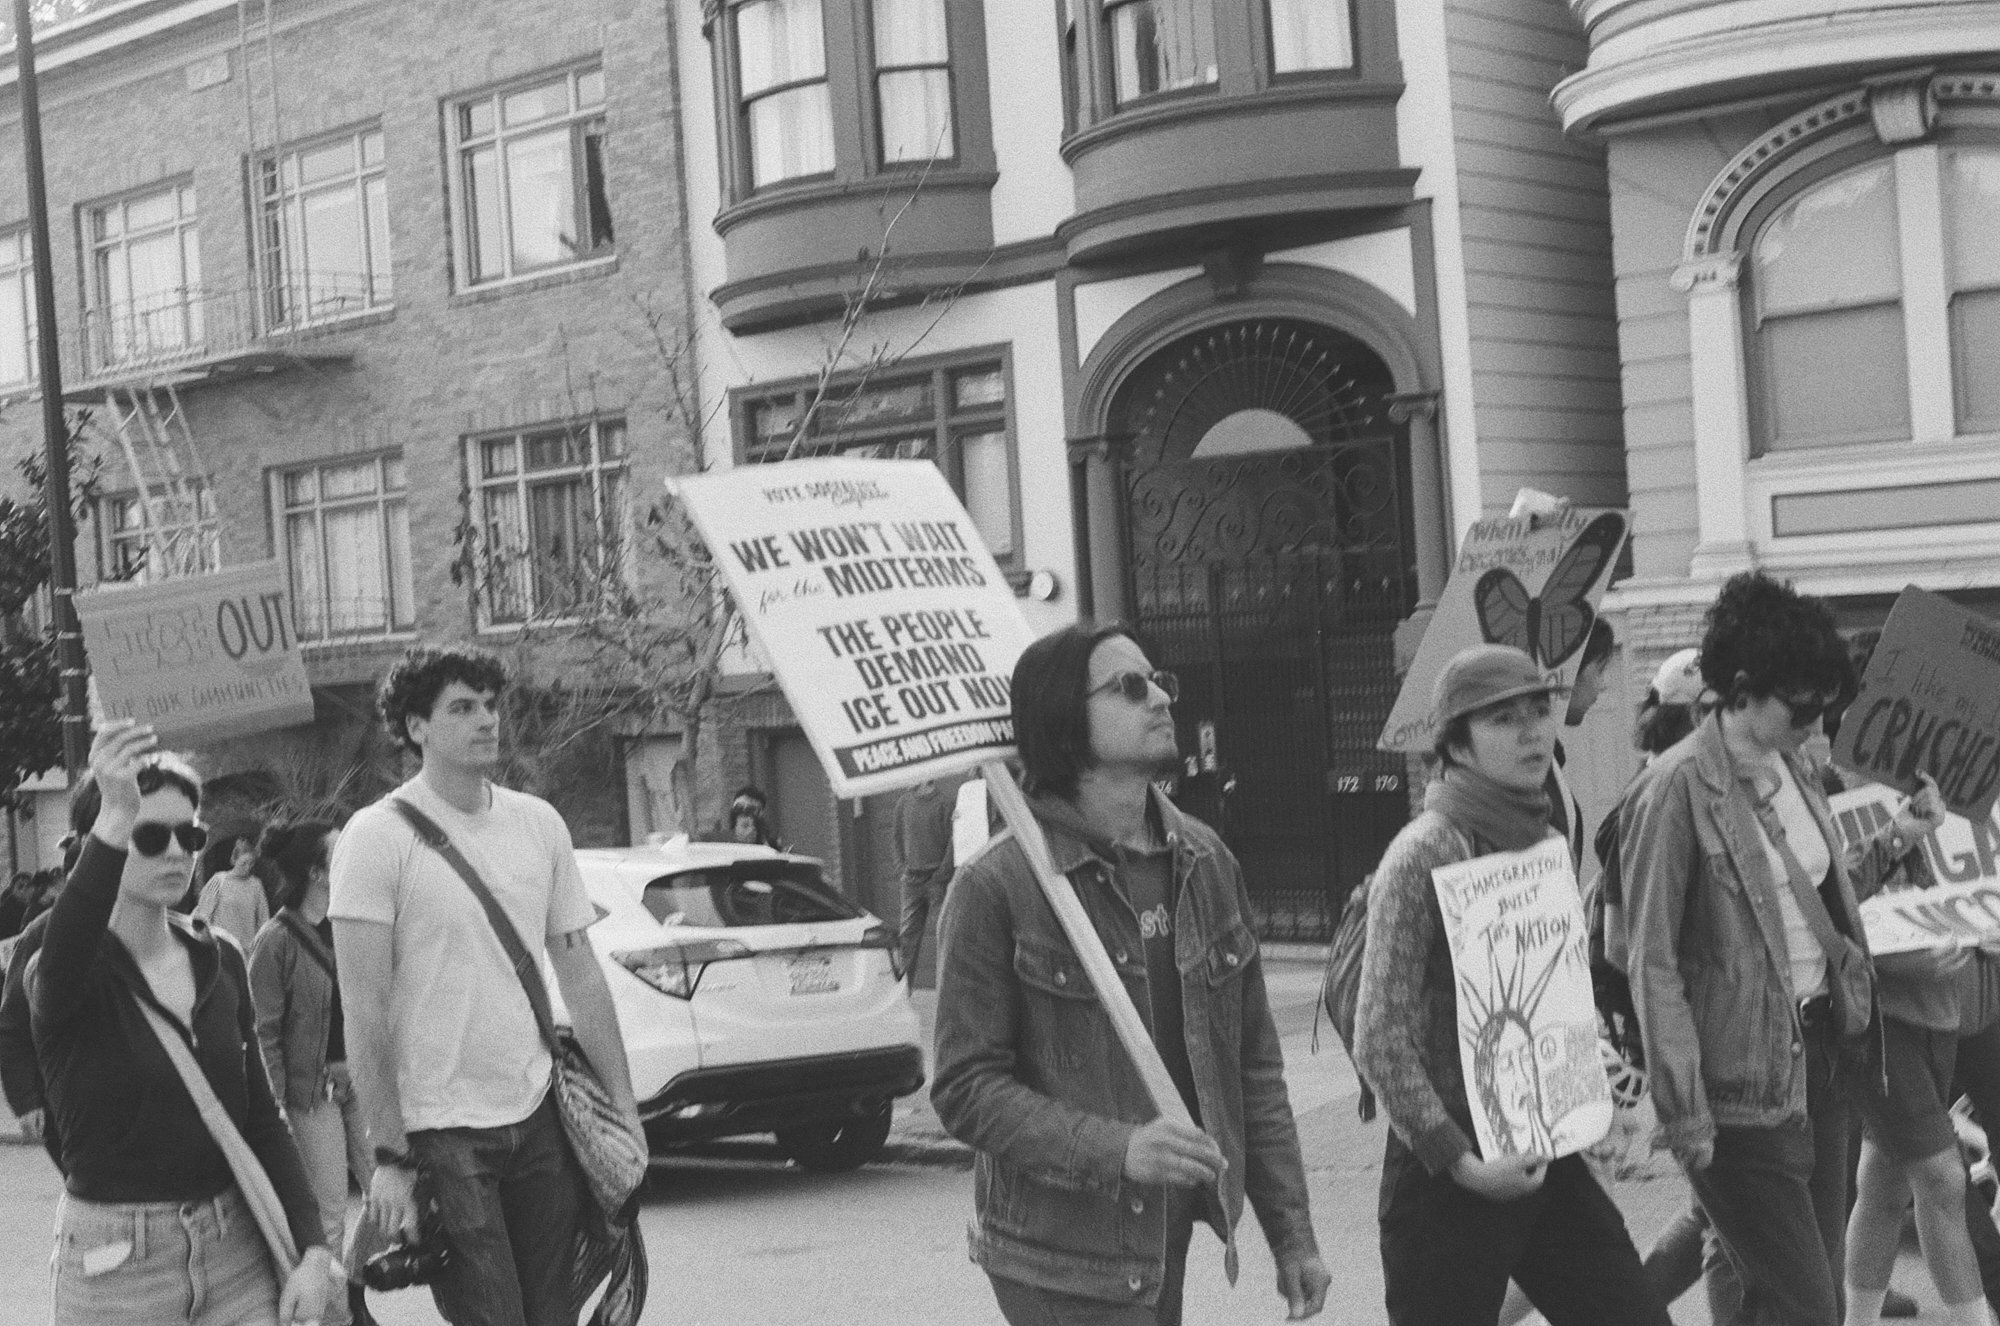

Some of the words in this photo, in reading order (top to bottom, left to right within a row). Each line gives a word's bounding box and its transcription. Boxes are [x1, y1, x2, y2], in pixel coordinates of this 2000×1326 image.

[730, 536, 790, 573] WE
[789, 521, 892, 564] WON'T
[892, 520, 969, 554] WAIT
[759, 588, 787, 614] for
[793, 578, 825, 599] the
[822, 555, 987, 599] MIDTERMS
[216, 591, 288, 661] OUT
[817, 616, 881, 659] THE
[880, 608, 990, 647] PEOPLE
[854, 642, 987, 691] DEMAND
[841, 690, 899, 734] ICE
[899, 680, 961, 720] OUT
[852, 740, 902, 773] PEACE
[898, 733, 932, 762] AND
[928, 721, 996, 754] FREEDOM
[1462, 853, 1564, 904] IMMIGRATION
[1514, 912, 1572, 956] NATION
